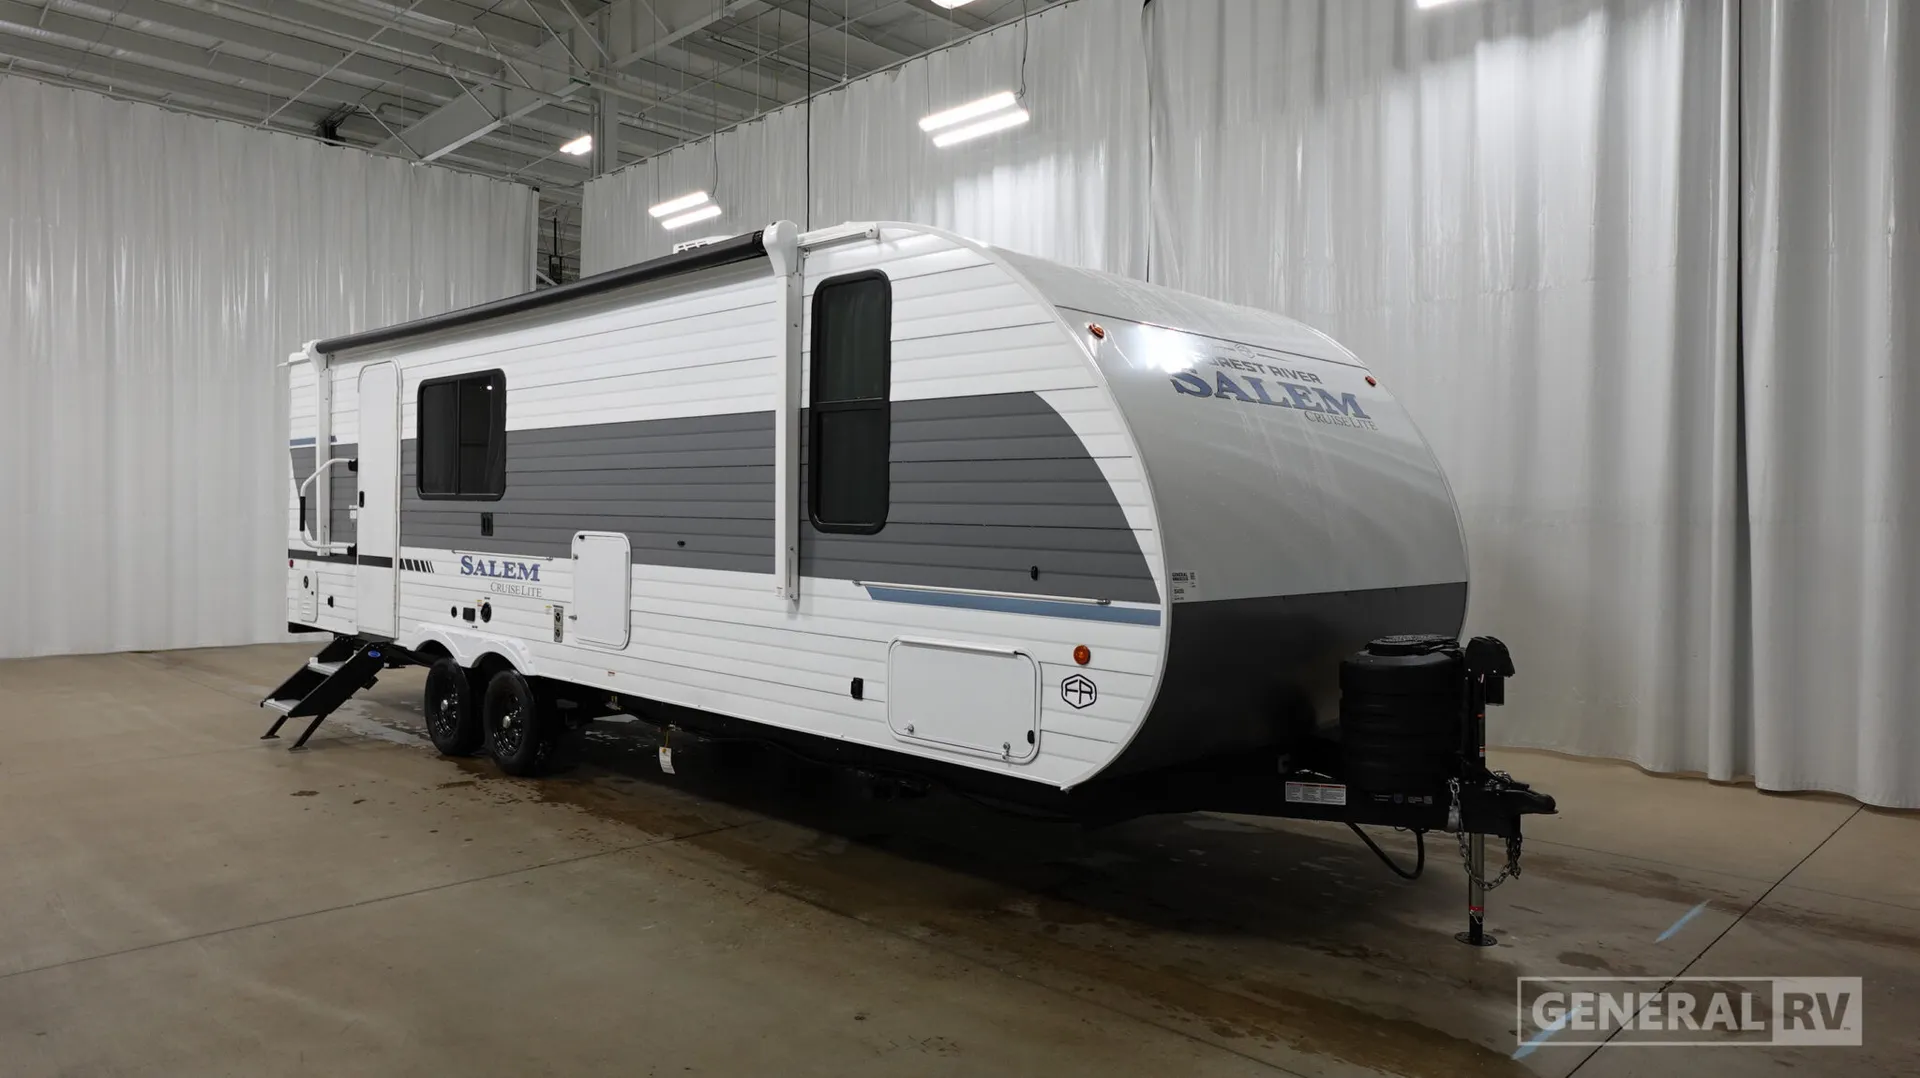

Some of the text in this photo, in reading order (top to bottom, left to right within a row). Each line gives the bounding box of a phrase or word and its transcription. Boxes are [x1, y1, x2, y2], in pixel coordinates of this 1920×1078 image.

[1208, 356, 1323, 385] REST RIVER
[1169, 369, 1370, 419] SALEM
[461, 555, 540, 582] SALEM
[1065, 679, 1093, 704] FR
